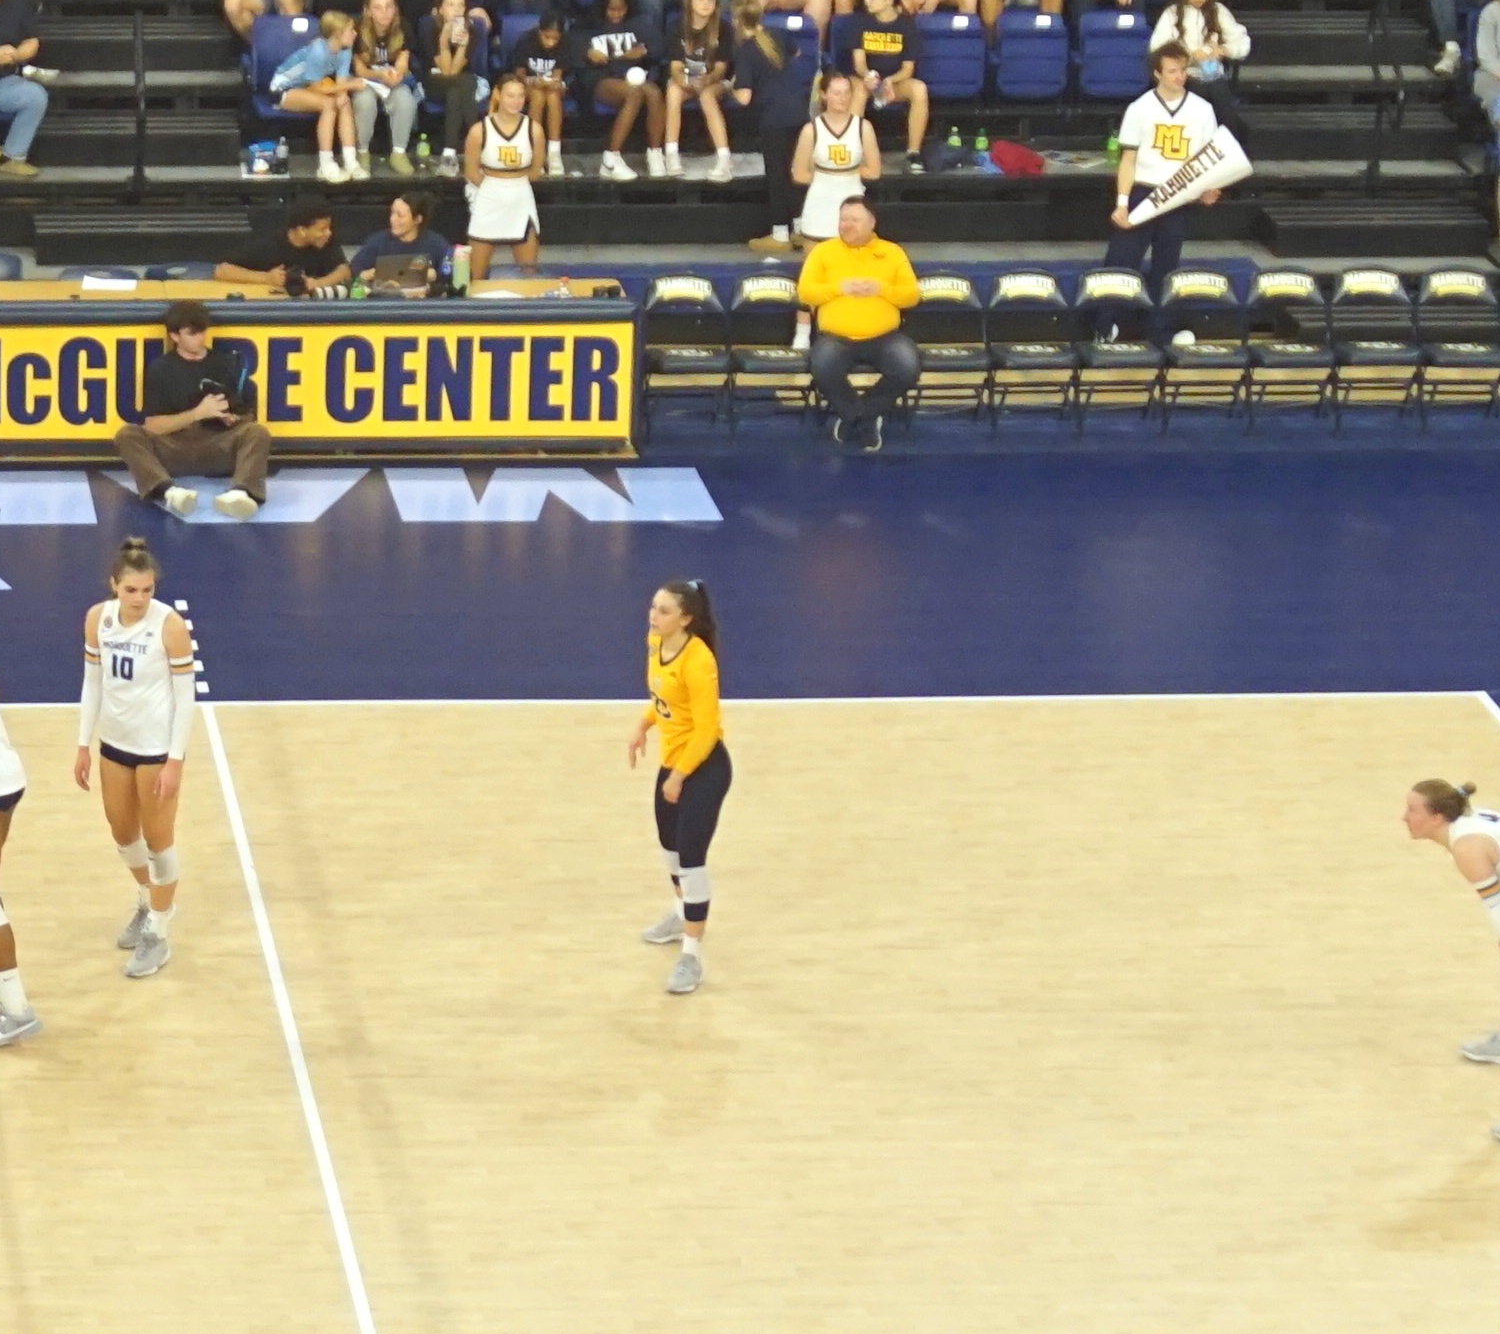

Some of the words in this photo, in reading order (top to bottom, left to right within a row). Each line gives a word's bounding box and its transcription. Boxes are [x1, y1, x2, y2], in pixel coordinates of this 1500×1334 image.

[828, 144, 852, 165] MU
[1153, 123, 1191, 161] MU
[498, 146, 523, 167] MU
[1150, 140, 1226, 211] MARQUETTE
[325, 331, 618, 423] CENTER
[103, 641, 148, 655] MARQUETTE
[112, 654, 134, 681] 10
